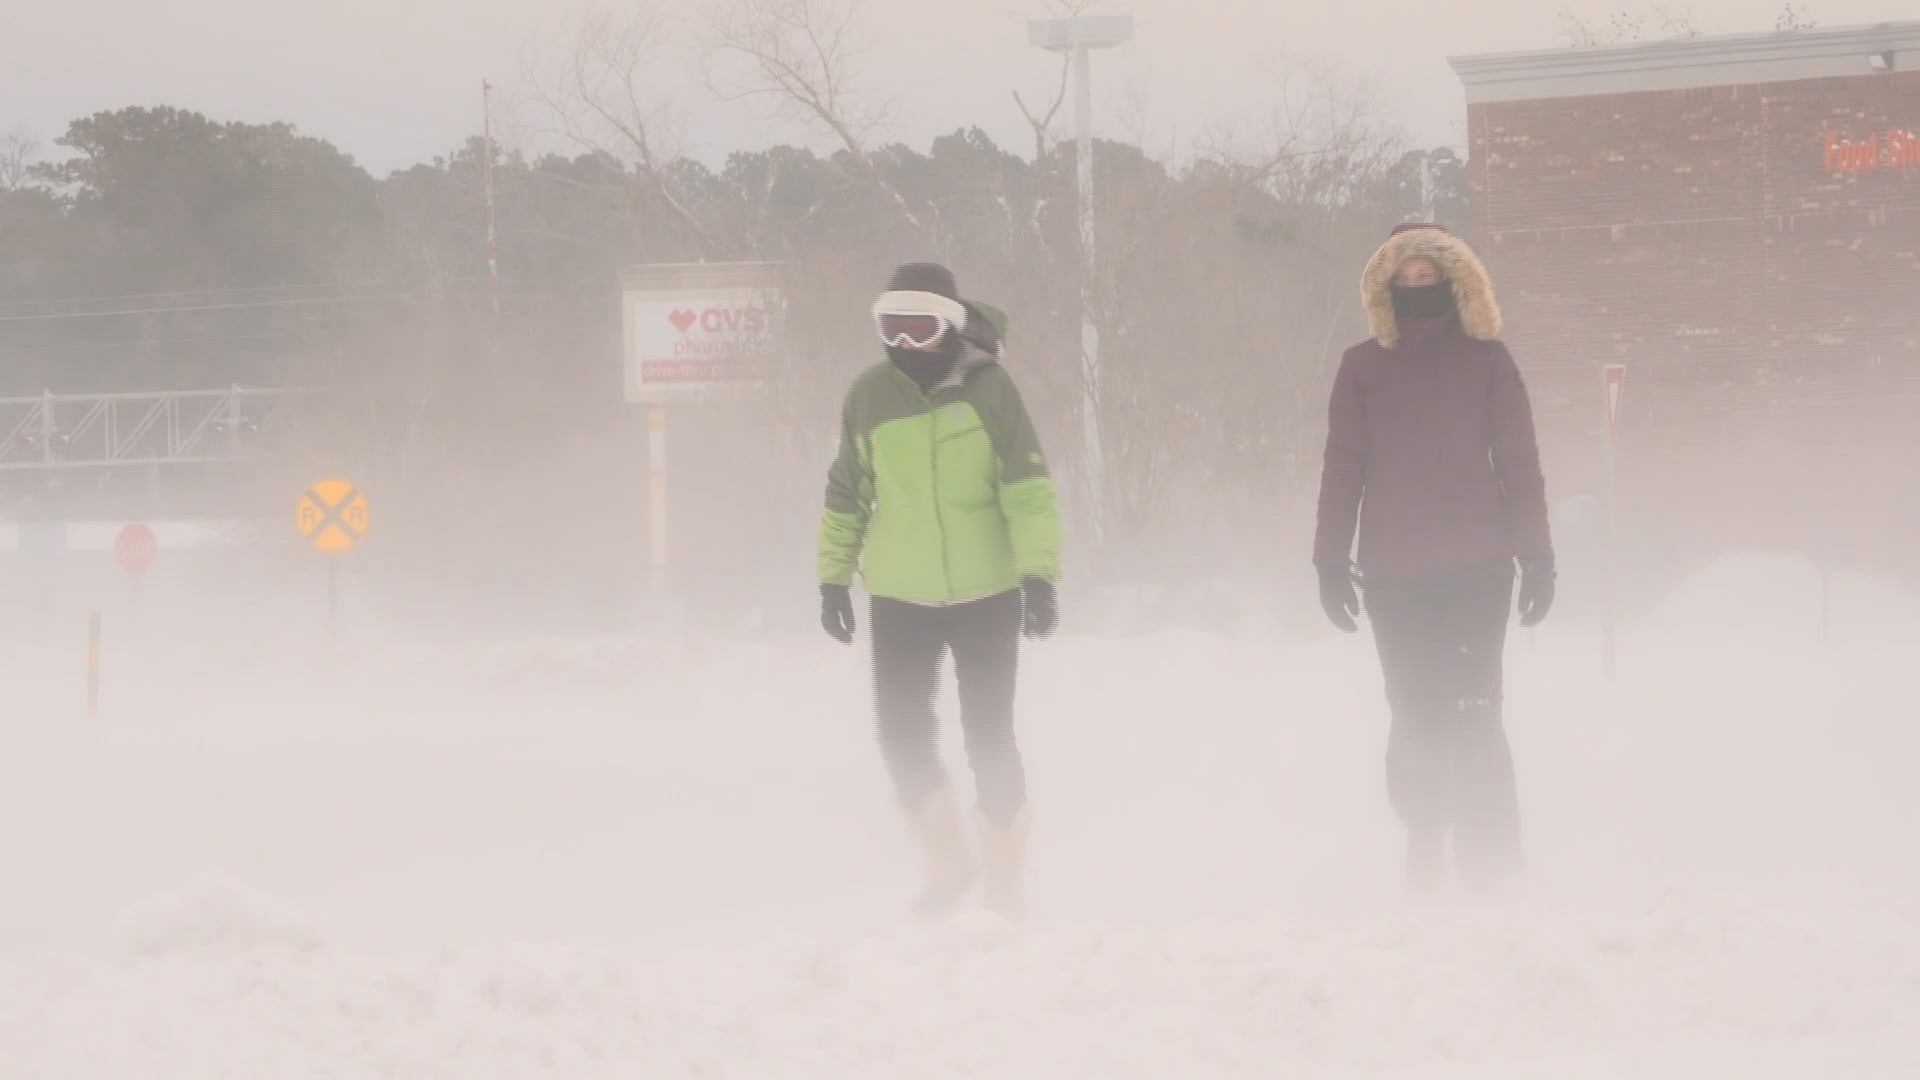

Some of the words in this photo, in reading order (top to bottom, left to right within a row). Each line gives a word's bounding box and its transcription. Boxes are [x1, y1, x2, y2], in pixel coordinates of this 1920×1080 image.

[700, 307, 765, 333] CVS
[302, 506, 316, 523] R
[350, 506, 363, 523] R
